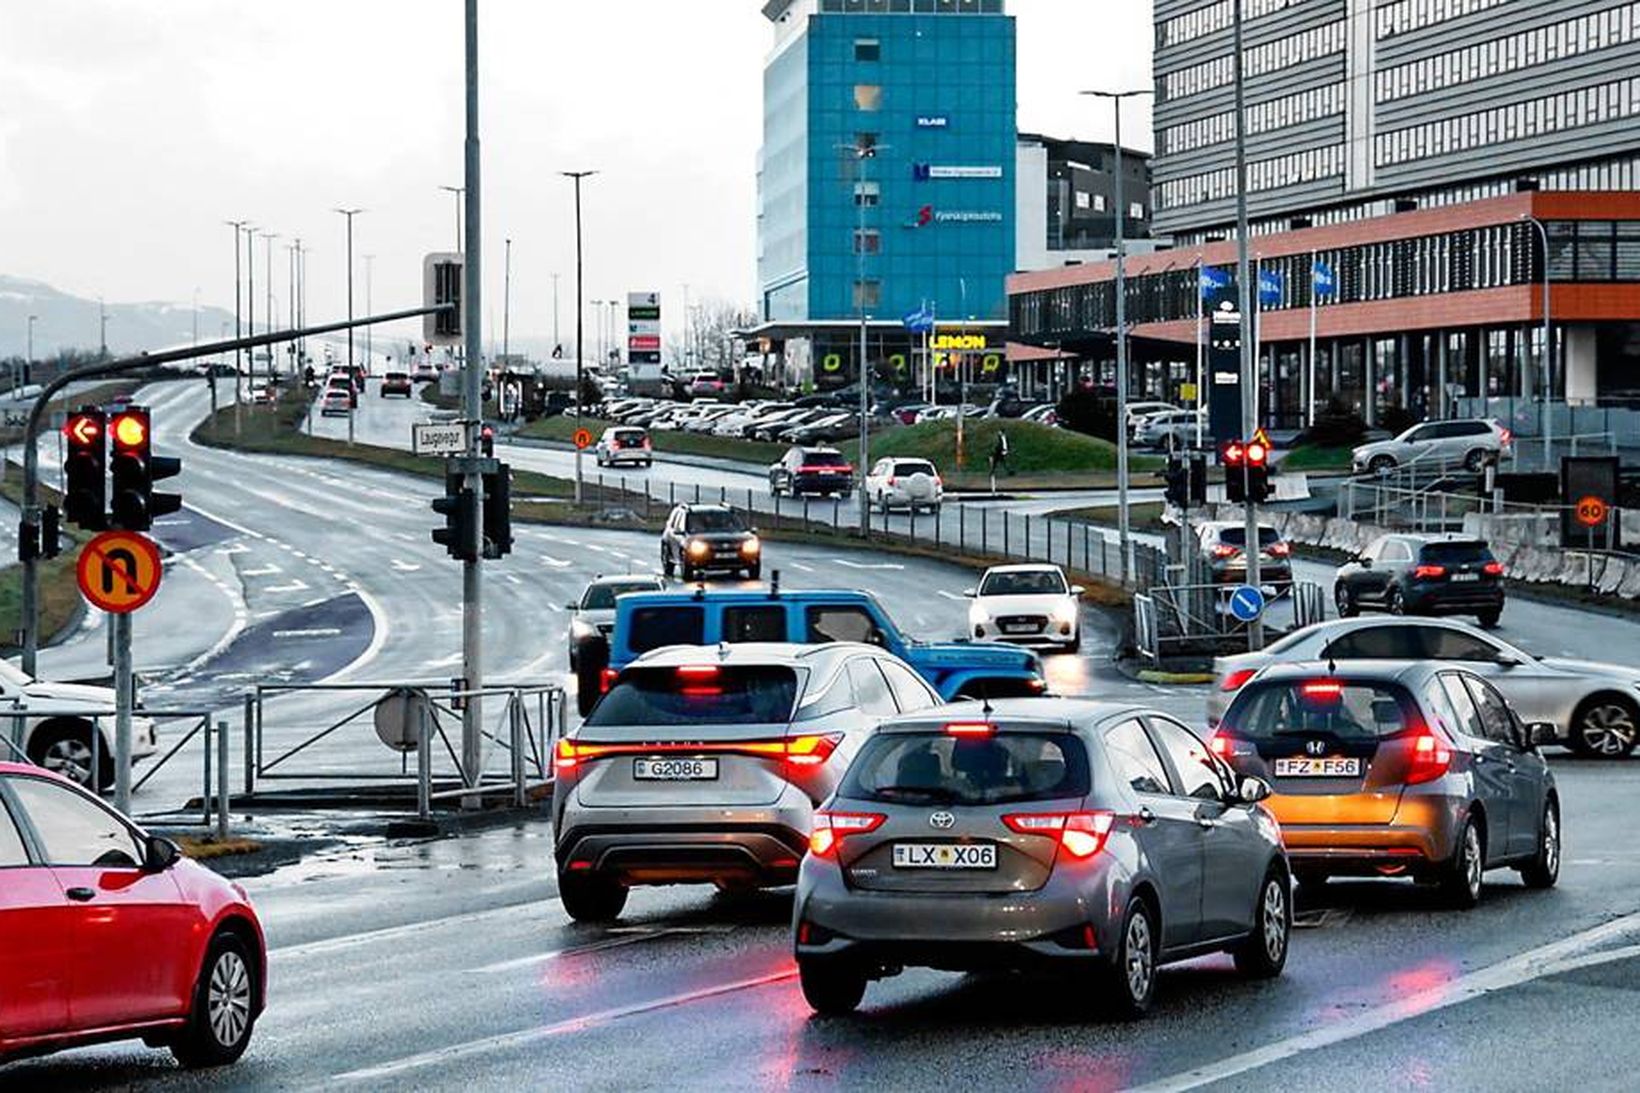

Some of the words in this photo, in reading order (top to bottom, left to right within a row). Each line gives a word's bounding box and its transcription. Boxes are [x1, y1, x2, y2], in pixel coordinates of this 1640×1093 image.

[929, 335, 986, 349] LEMON
[1580, 505, 1602, 517] 60
[651, 761, 703, 775] G2086
[1287, 760, 1311, 773] FZ
[1323, 760, 1356, 773] F56
[908, 847, 935, 864] LX
[954, 847, 993, 864] X06
